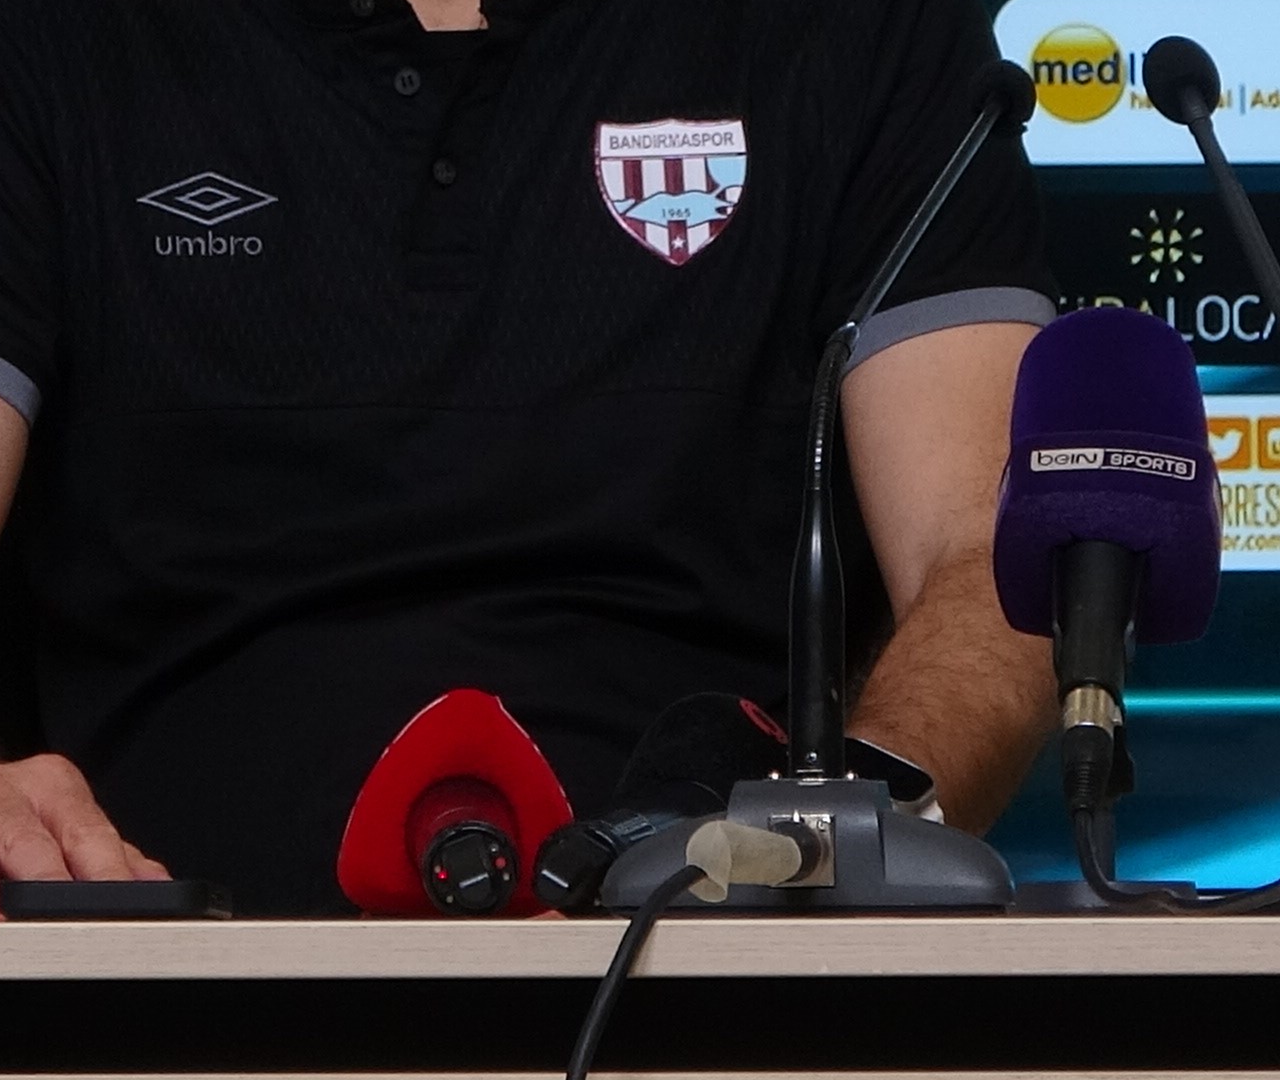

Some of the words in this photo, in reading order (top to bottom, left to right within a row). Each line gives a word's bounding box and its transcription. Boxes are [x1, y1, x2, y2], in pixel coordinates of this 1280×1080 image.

[609, 132, 734, 150] BANDIRMASPOR
[155, 232, 263, 256] umbro
[1109, 455, 1188, 475] SPORTS
